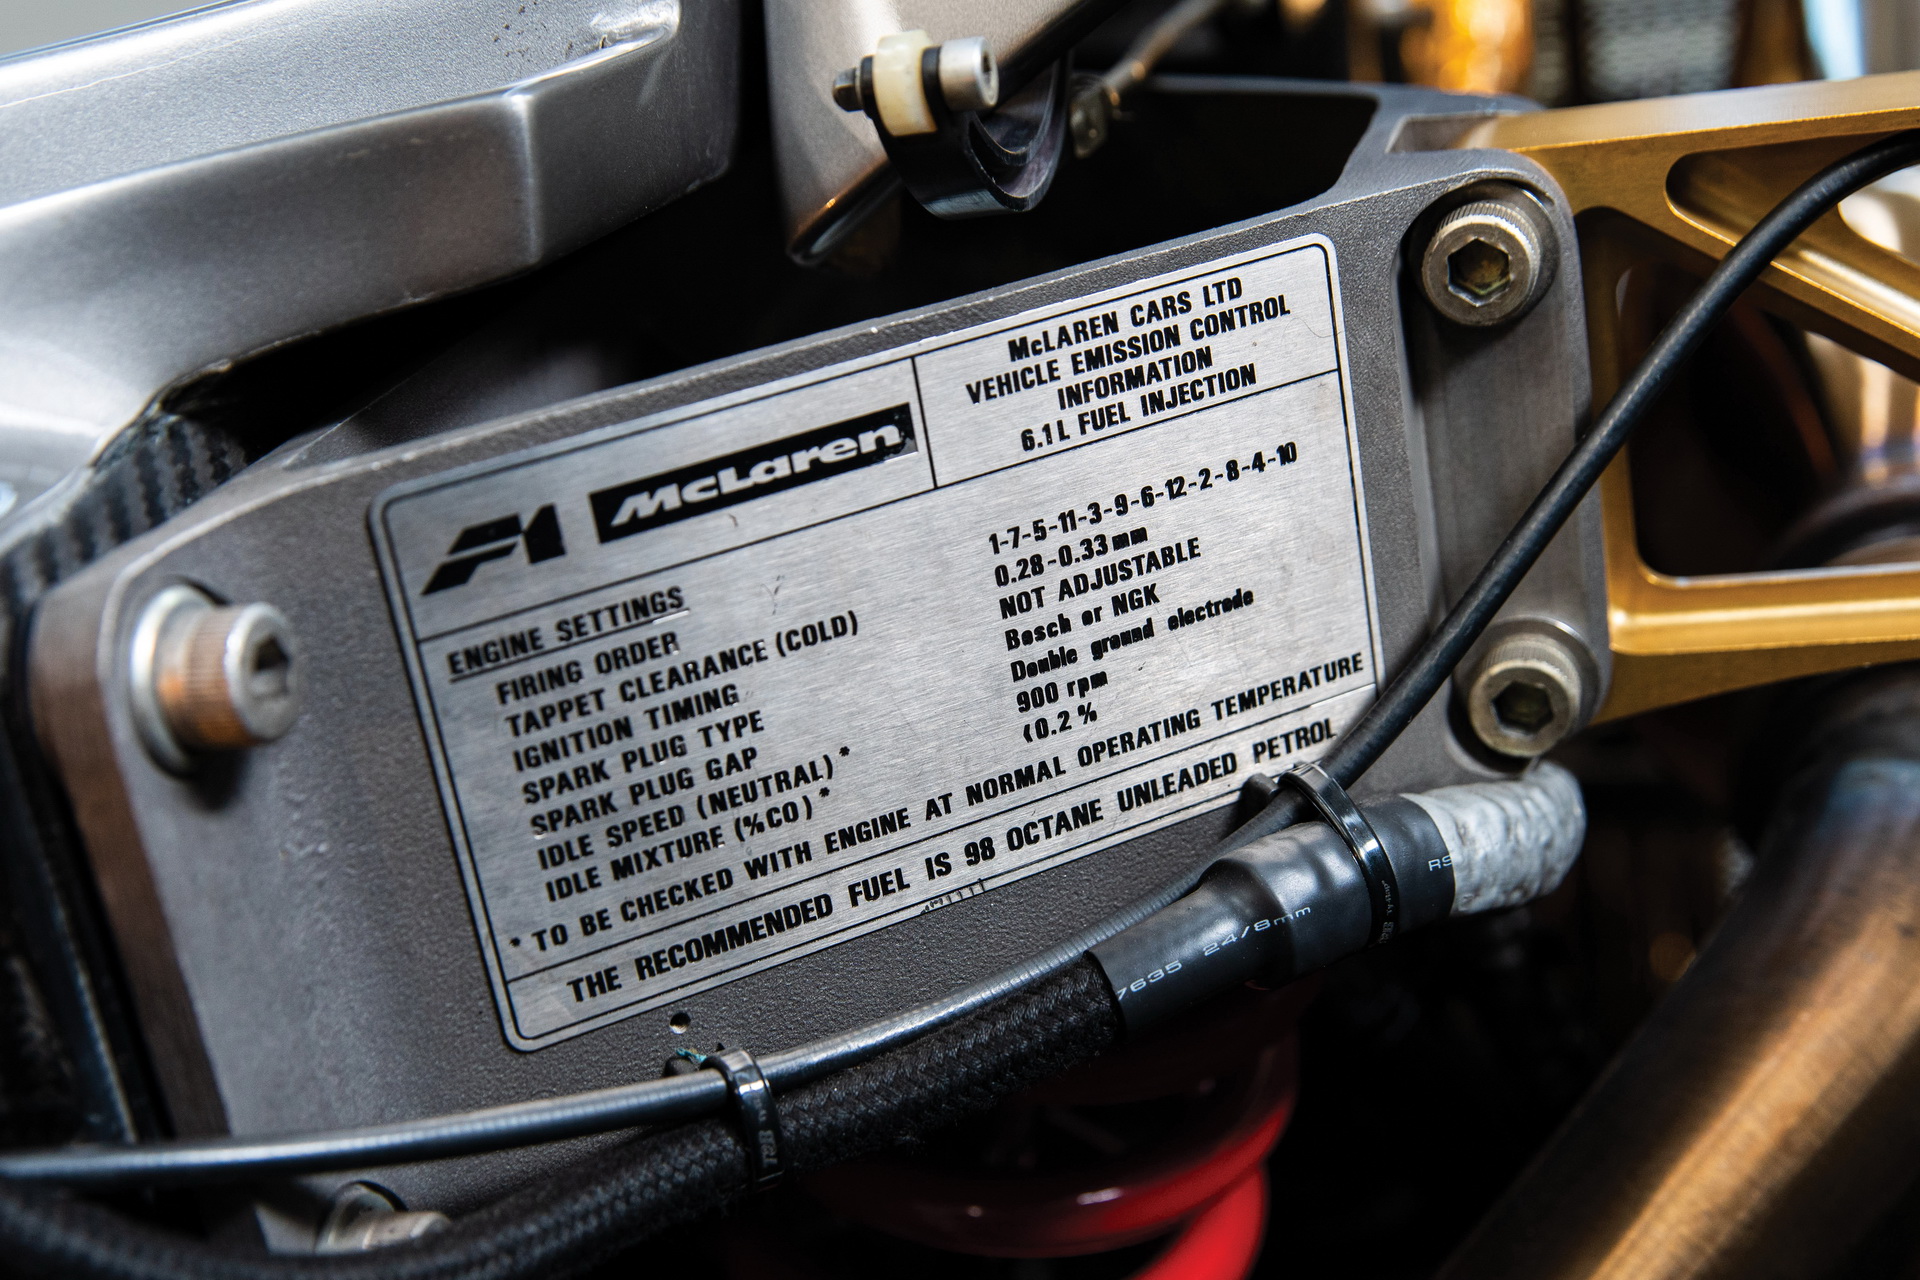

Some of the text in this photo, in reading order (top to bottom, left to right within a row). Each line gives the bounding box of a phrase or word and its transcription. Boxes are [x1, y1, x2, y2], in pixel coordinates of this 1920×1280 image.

[965, 294, 1291, 404] VEHICLE EMISSION CONTROL
[1008, 277, 1242, 362] McLAREN CARS LTD
[1057, 345, 1213, 410] INFORMATION
[1077, 401, 1131, 436] FUEL
[1140, 363, 1256, 417] INJECTION
[610, 423, 903, 527] McLaren
[989, 441, 1297, 555] 1-7-5-11-3-9-6-12-2-8-4-10
[999, 537, 1201, 620] NOT ADJUSTABLE
[1004, 583, 1160, 651] Bosch or NGK
[448, 586, 684, 676] ENGINE SETTINGS
[496, 631, 680, 705] FIRING ORDER
[505, 610, 858, 738] TAPPET CLEARANCE (COLD)
[1010, 588, 1254, 683] Double ground electrode
[513, 684, 740, 772] IGNITION TIMING
[1016, 671, 1108, 713] 900 rpm
[522, 710, 764, 804] SPARK PLUG TYPE
[530, 747, 757, 835] SPARK PLUG GAP
[531, 924, 568, 952] TO
[579, 908, 613, 937] BE
[620, 868, 734, 922] CHECKED
[743, 841, 812, 880] WITH
[824, 807, 911, 855] ENGINE
[925, 792, 953, 821] AT
[965, 756, 1067, 807] NORMAL
[1077, 708, 1201, 768] OPERATING
[1210, 652, 1363, 721] TEMPERATURE
[537, 834, 594, 870] IDLE
[605, 805, 686, 848] SPEED
[545, 866, 602, 902] IDLE
[610, 825, 725, 881] MIXTURE
[566, 718, 1336, 1002] THE RECOMMENDED FUEL IS 98 OCTANE UNLEADED PETROL
[1203, 905, 1312, 956] 24/8mm
